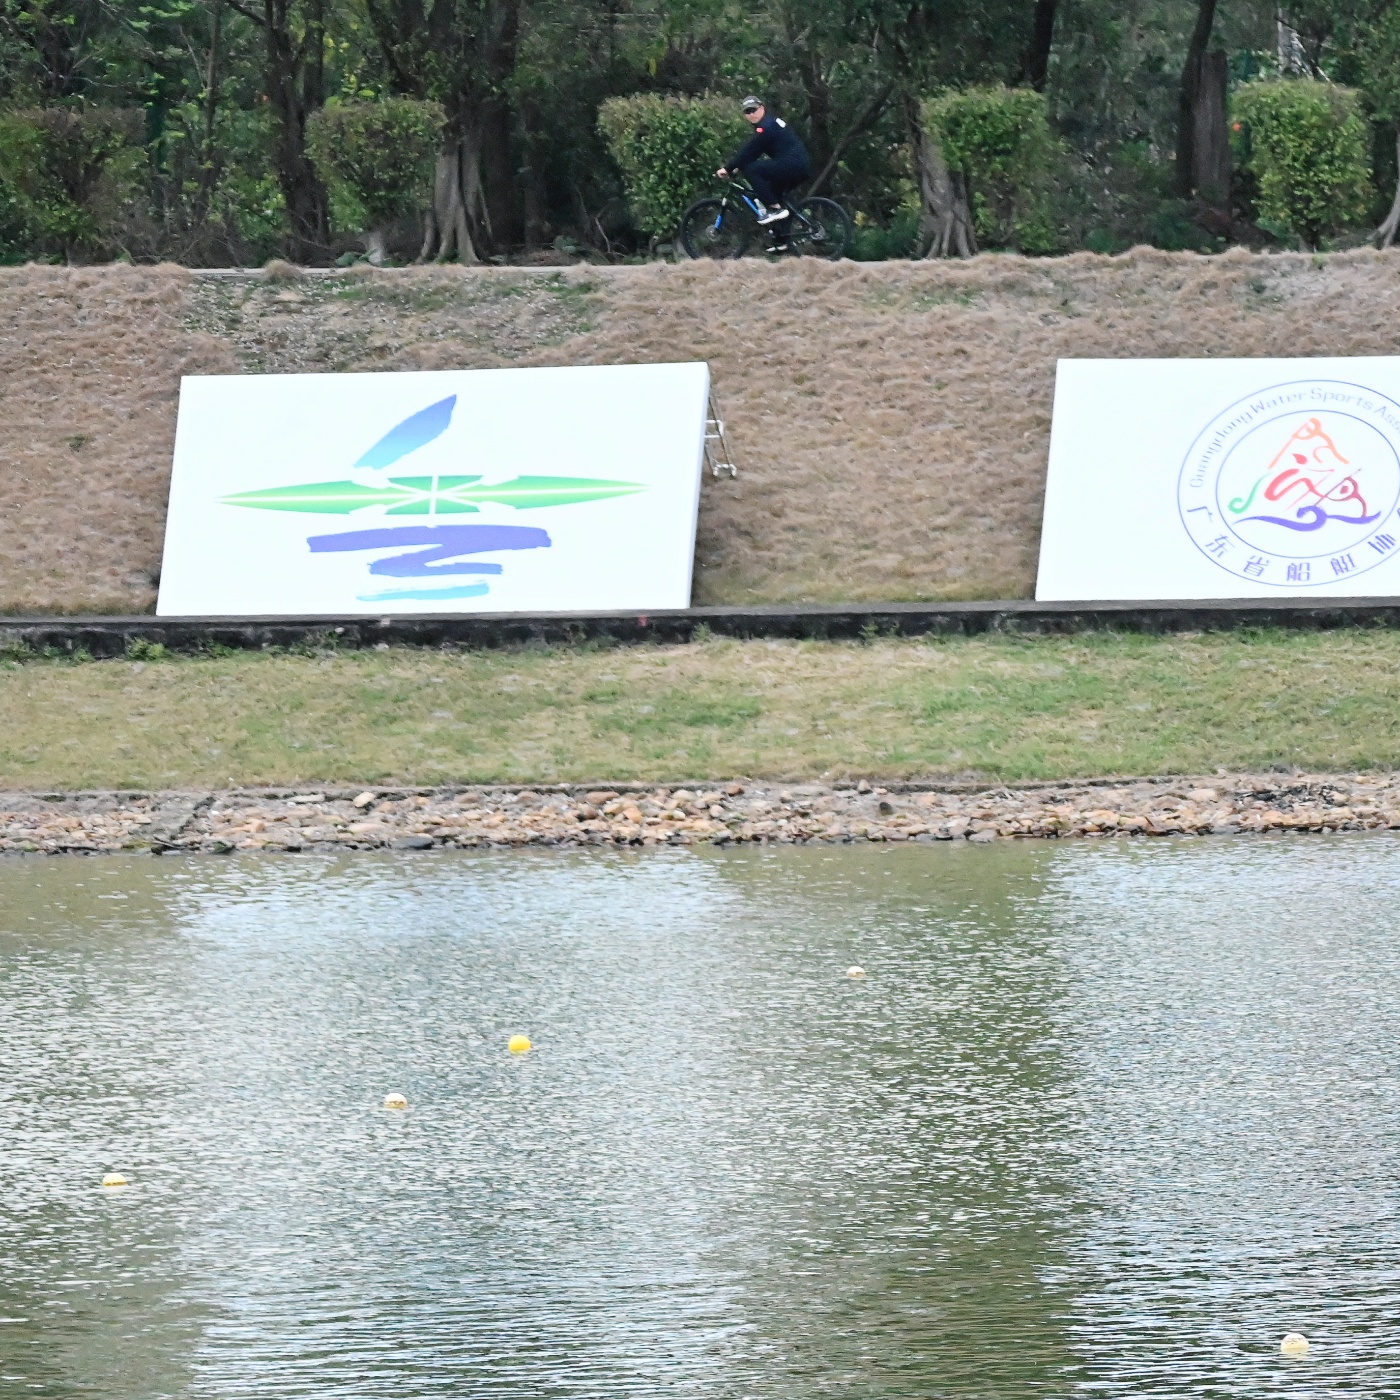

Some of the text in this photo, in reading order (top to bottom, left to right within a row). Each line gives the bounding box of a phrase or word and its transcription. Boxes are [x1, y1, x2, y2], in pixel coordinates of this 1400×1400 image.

[1189, 411, 1253, 489] Guangdong
[1250, 391, 1303, 421] Water
[1310, 387, 1372, 410] Sports
